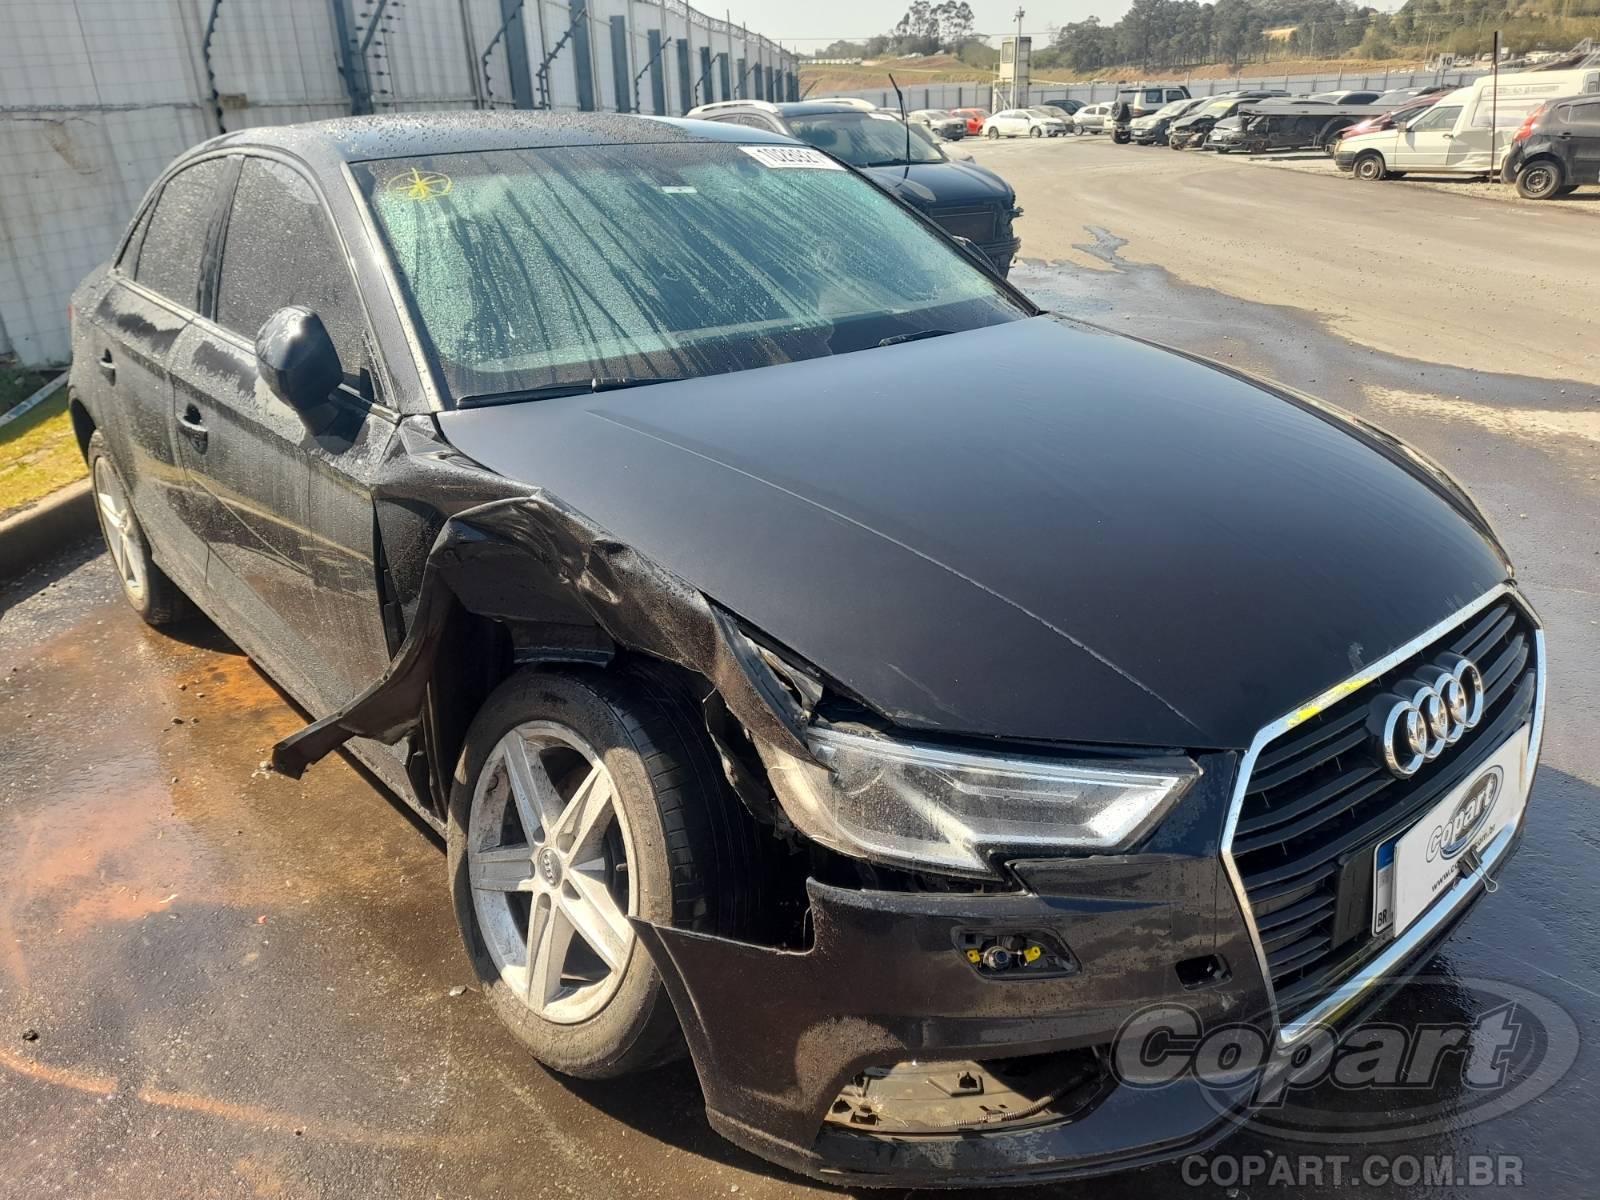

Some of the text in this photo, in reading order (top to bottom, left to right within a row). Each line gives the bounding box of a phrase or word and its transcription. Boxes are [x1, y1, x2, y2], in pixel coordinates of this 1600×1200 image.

[1441, 57, 1453, 66] 10
[1426, 773, 1496, 863] Copart
[1377, 909, 1387, 927] BR
